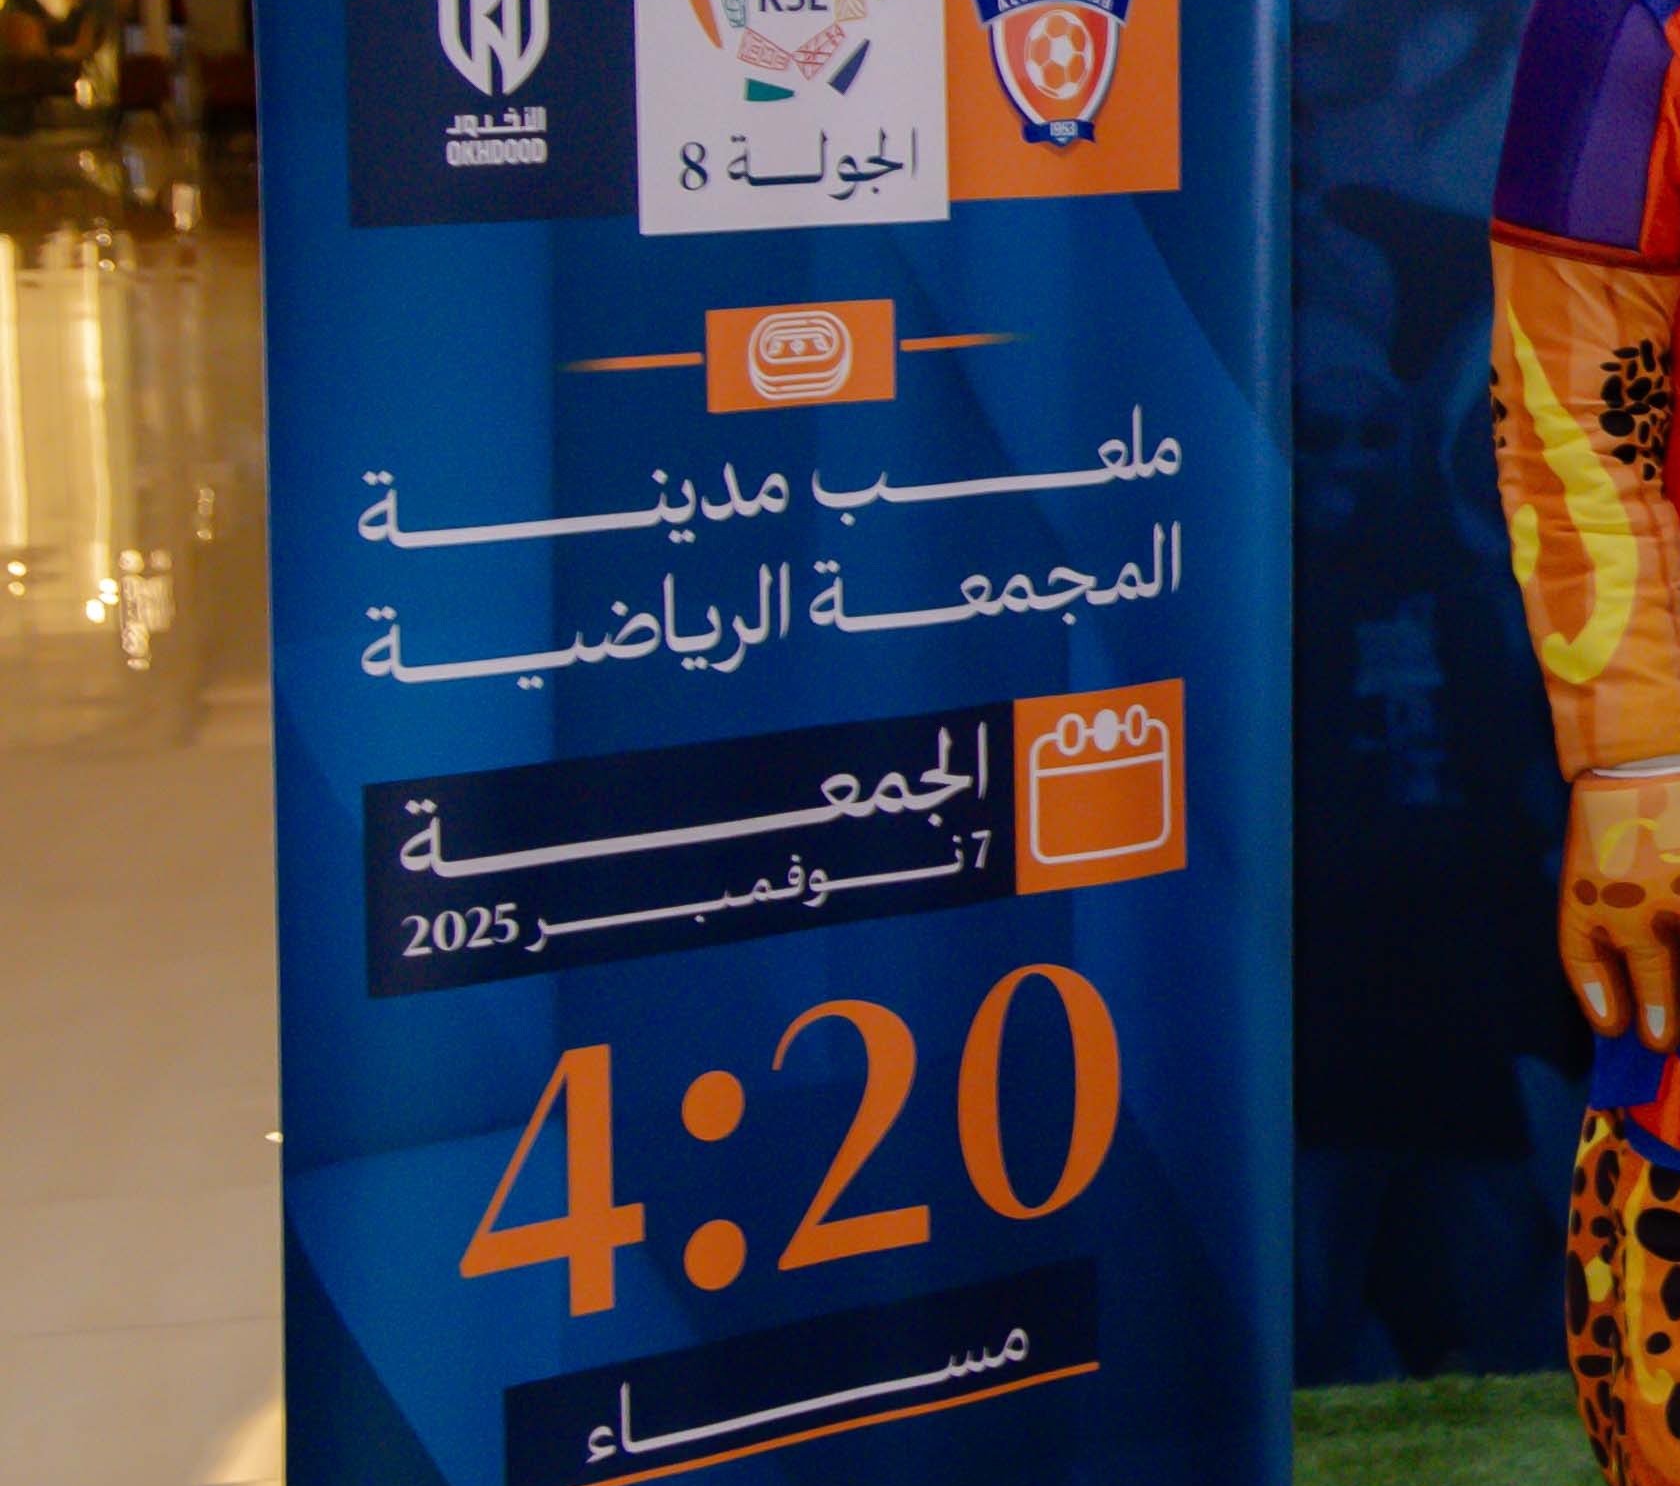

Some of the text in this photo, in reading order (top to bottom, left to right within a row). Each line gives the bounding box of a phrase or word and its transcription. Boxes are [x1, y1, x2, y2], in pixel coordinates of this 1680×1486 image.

[446, 137, 548, 167] OKHDOOD
[679, 126, 918, 203] الجولة 8
[358, 404, 1182, 550] ملعب مدينة
[360, 520, 1182, 691] المجمعة الرياضية
[399, 721, 989, 878] الجمعة
[401, 829, 991, 958] 7 نوفمبر 2025
[459, 963, 1121, 1317] 4:20
[586, 1324, 1030, 1464] مساء
